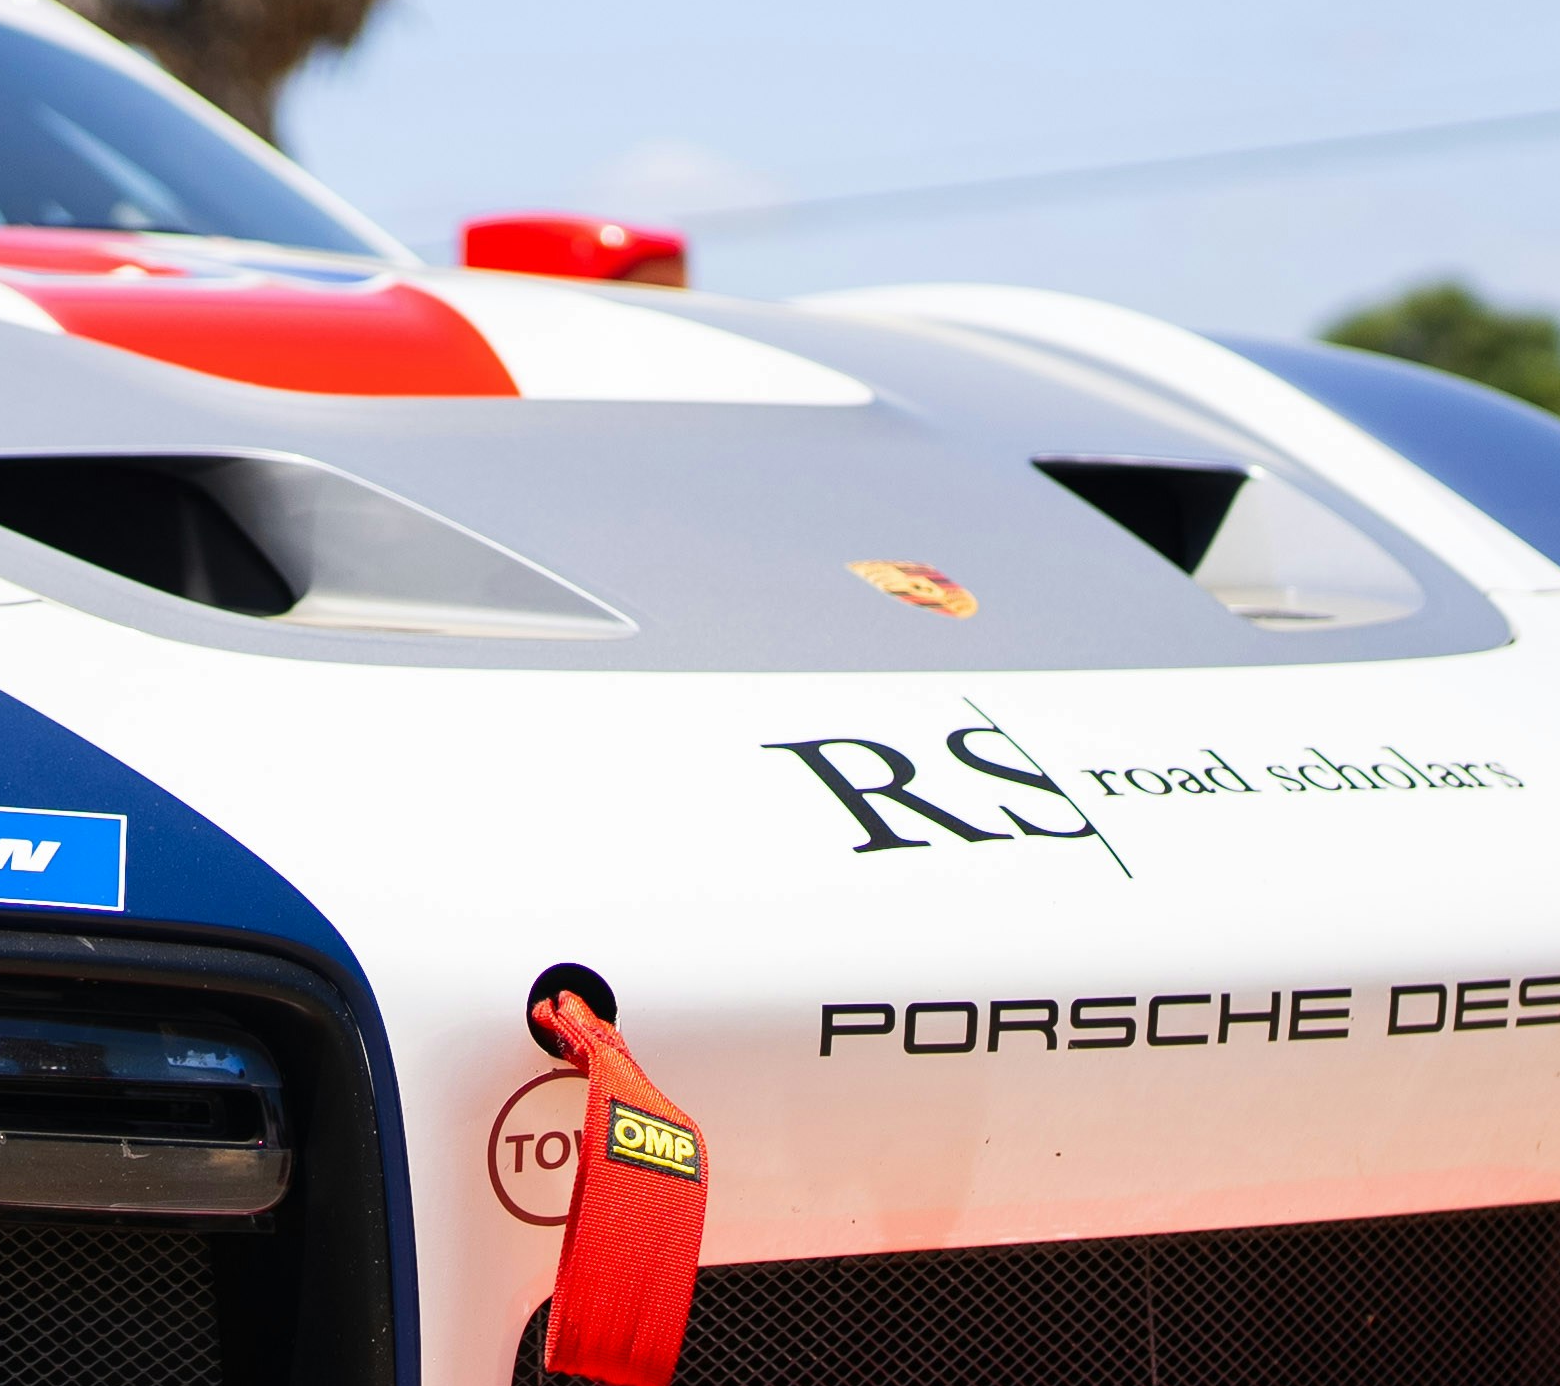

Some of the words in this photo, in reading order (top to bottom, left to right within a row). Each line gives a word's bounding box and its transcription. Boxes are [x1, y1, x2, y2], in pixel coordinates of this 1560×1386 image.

[760, 725, 1098, 854] RS
[1080, 749, 1261, 798] road
[1266, 745, 1527, 793] scholars
[818, 988, 1353, 1058] PORSCHE
[505, 1130, 584, 1173] TO
[614, 1117, 696, 1164] OMP
